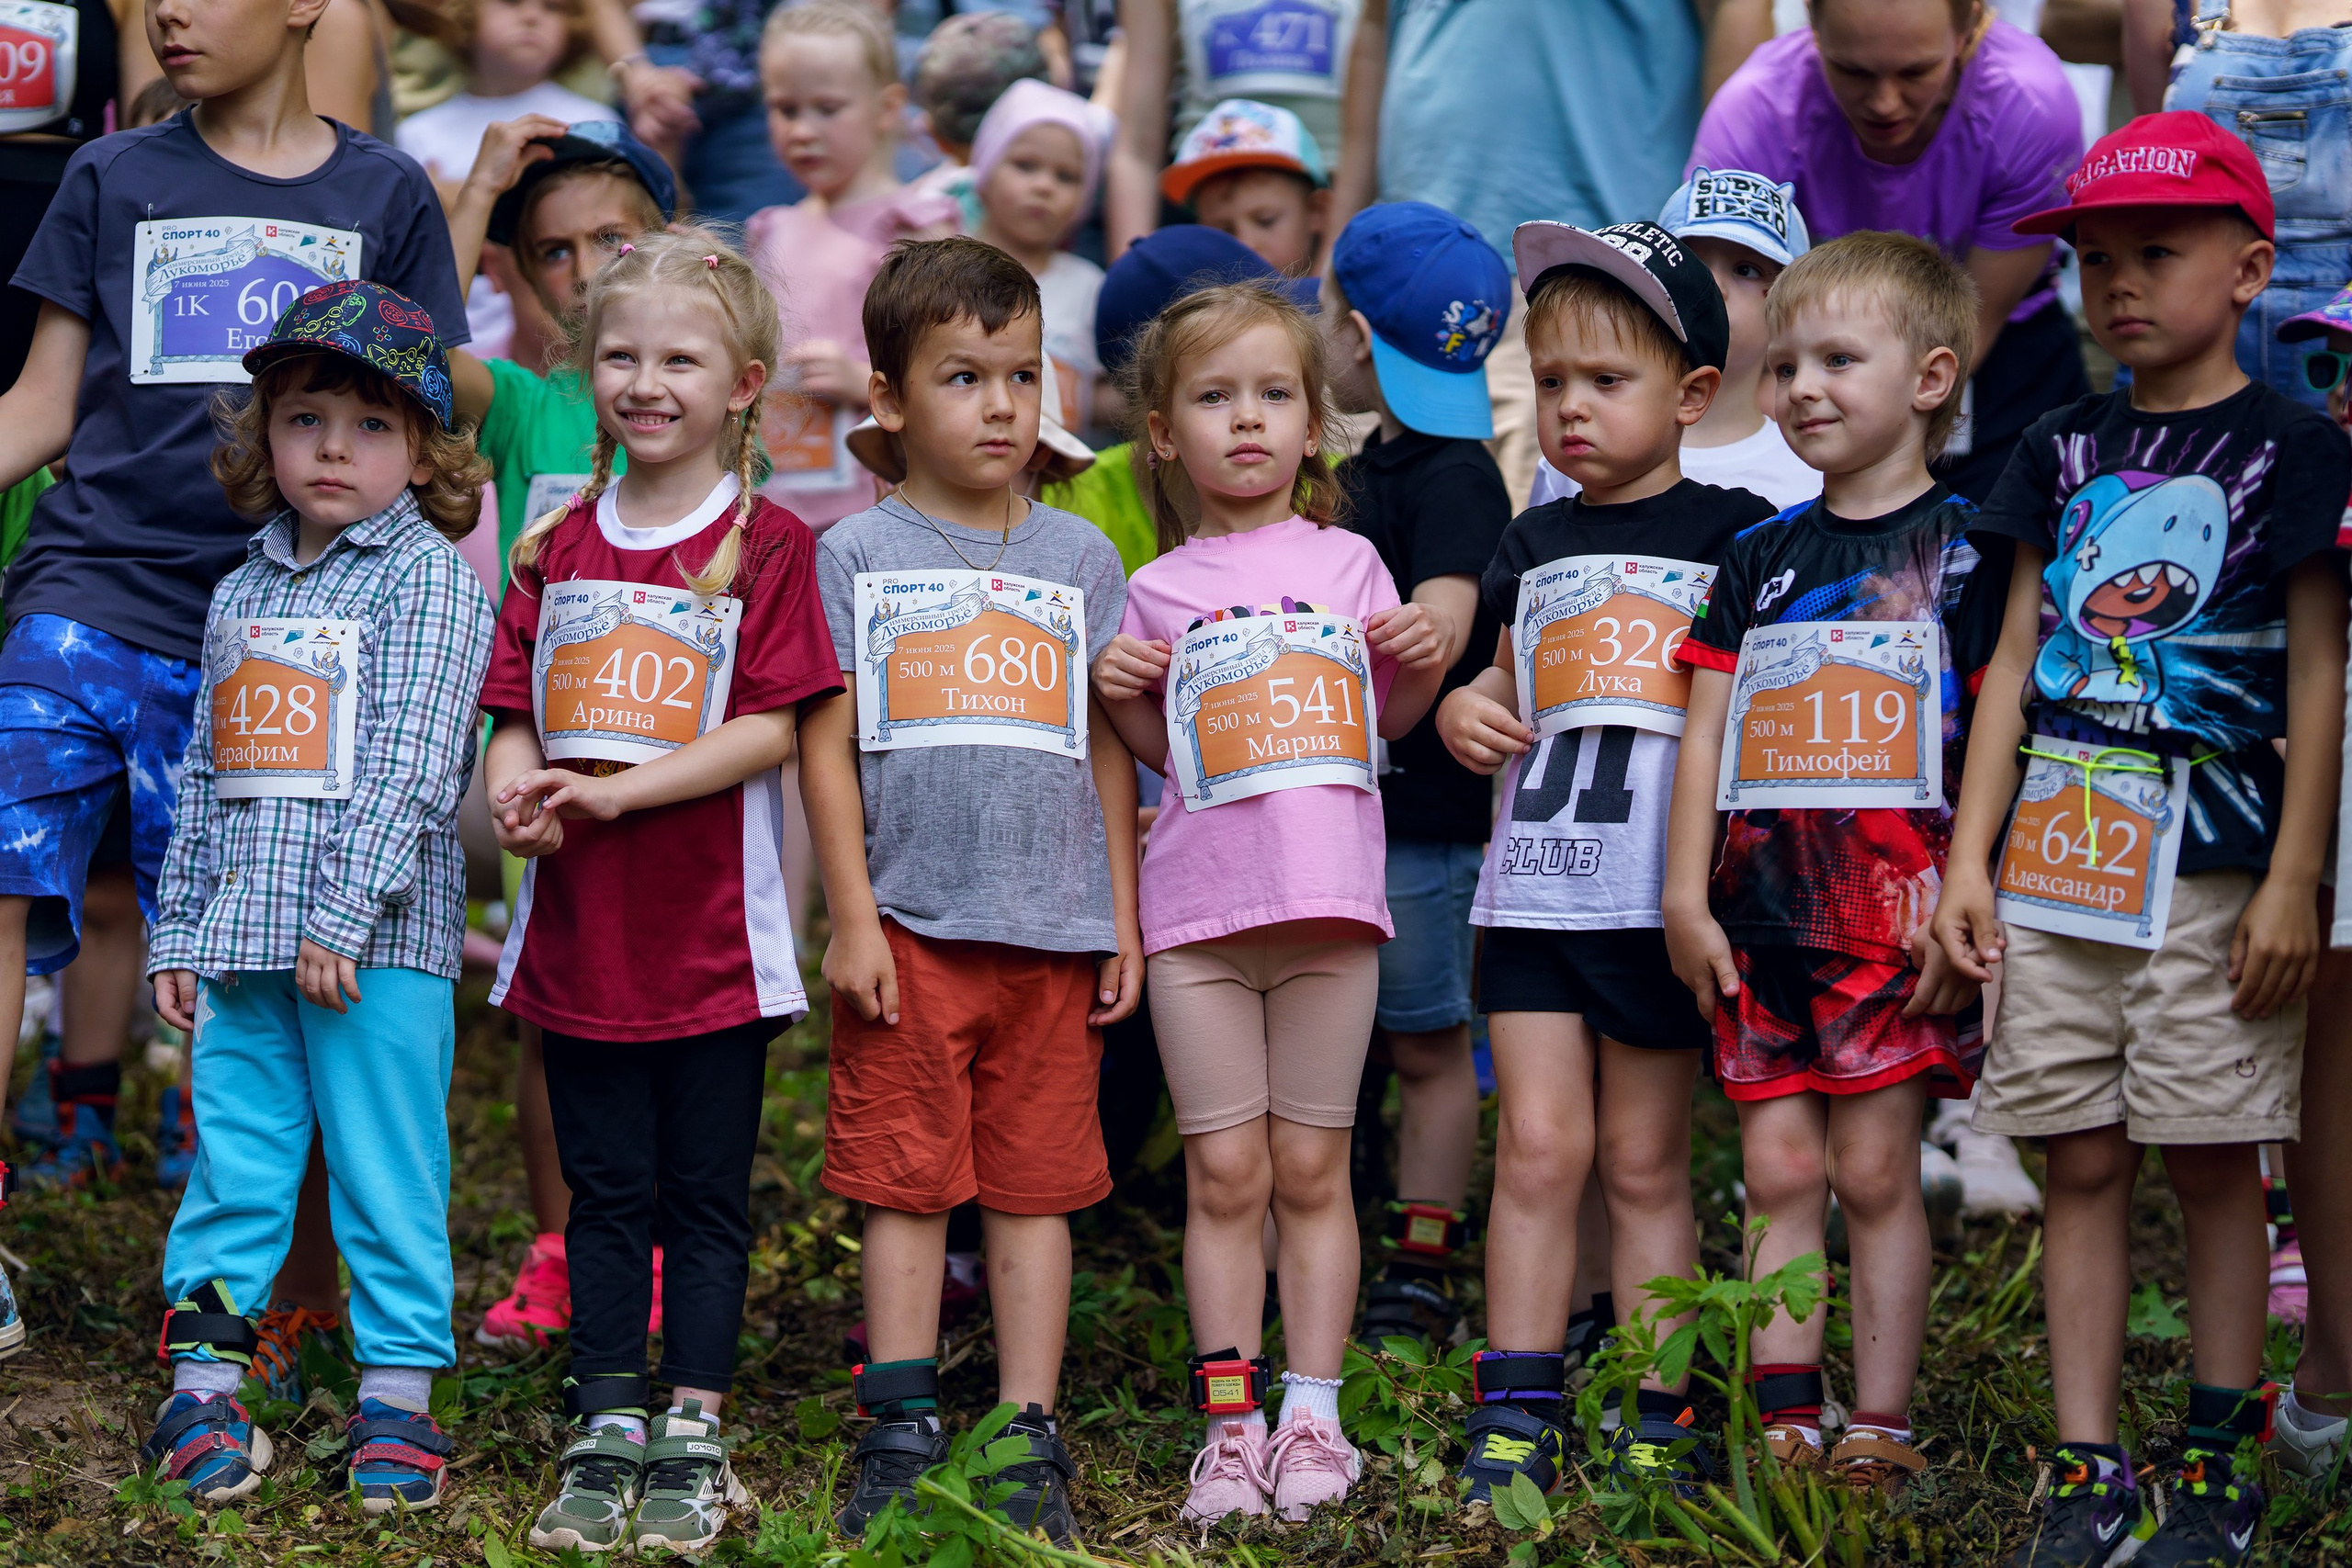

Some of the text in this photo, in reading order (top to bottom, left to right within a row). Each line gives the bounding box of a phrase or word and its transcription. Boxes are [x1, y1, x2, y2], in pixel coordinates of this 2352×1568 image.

[1248, 12, 1329, 52] 471
[0, 40, 48, 83] 09
[162, 229, 220, 240] СПОРТ 40
[159, 254, 247, 282] Лукоморье
[174, 280, 180, 288] 7
[209, 279, 230, 288] 2025
[237, 277, 319, 325] 60
[226, 327, 269, 350] Его
[883, 583, 944, 594] СПОРТ 40
[1536, 570, 1578, 588] СПОРТ 40
[554, 594, 589, 605] СПОРТ 40
[1532, 593, 1604, 634] Лукоморье
[548, 621, 610, 651] Лукоморье
[881, 609, 973, 640] Лукоморье
[1542, 637, 1546, 645] 7
[1567, 628, 1585, 638] 2025
[898, 644, 956, 655] 7 июня 2025
[1185, 633, 1238, 654] СПОРТ 40
[1589, 616, 1690, 673] 326
[1752, 637, 1787, 651] СПОРТ 40
[574, 657, 590, 665] 2025
[899, 660, 956, 679] 500 м
[964, 634, 1057, 692] 680
[1542, 647, 1583, 669] 500 м
[552, 673, 587, 691] 500 м
[594, 648, 695, 710] 402
[1187, 655, 1271, 700] Лукоморье
[1576, 670, 1642, 698] Лука
[1744, 664, 1811, 698] Лукоморье
[230, 684, 317, 736] 428
[941, 687, 1026, 714] Тихон
[1203, 692, 1259, 711] 7 июня 2025
[1267, 675, 1358, 728] 541
[1776, 702, 1794, 711] 2025
[571, 700, 655, 730] Арина
[1206, 712, 1261, 735] 500 м
[1749, 719, 1794, 738] 500 м
[1804, 690, 1906, 744] 119
[215, 739, 299, 771] Серафим
[1246, 733, 1342, 761] Мария
[1762, 747, 1892, 780] Тимофей
[1499, 837, 1603, 876] CLUB
[2026, 839, 2037, 852] м
[2041, 811, 2138, 877] 642
[2005, 861, 2126, 912] Александр
[688, 1442, 720, 1454] JOMOTO
